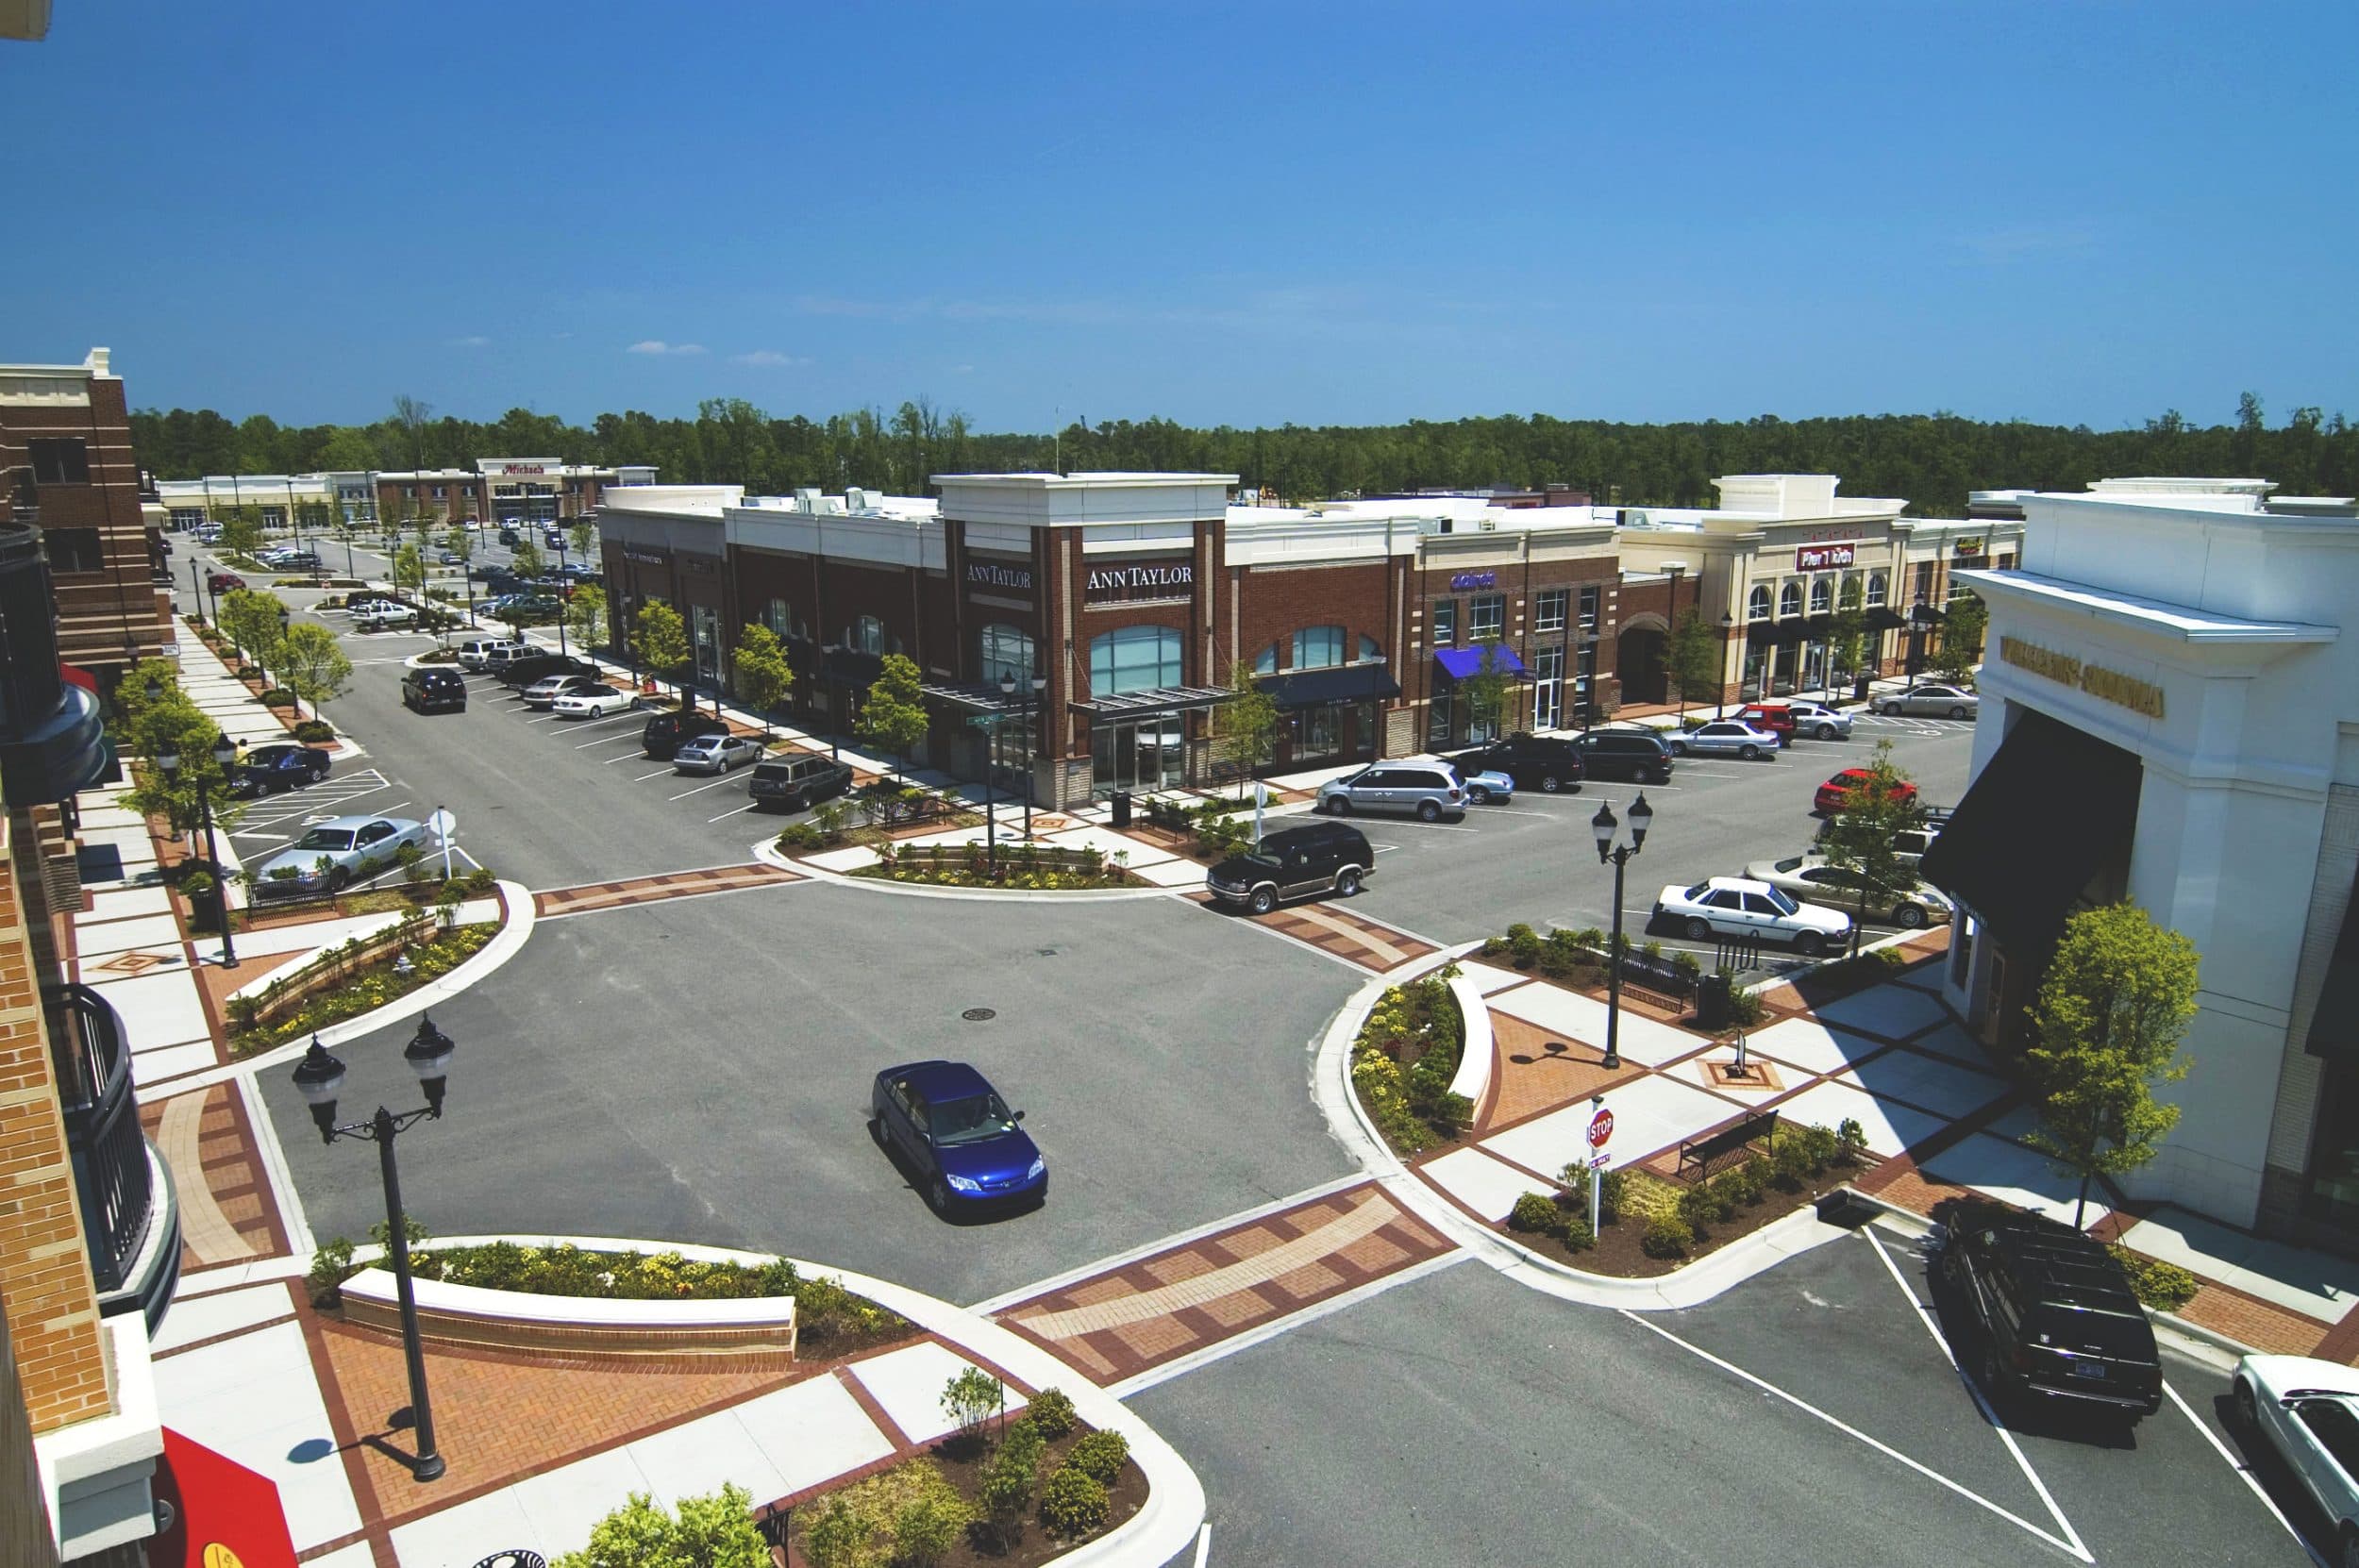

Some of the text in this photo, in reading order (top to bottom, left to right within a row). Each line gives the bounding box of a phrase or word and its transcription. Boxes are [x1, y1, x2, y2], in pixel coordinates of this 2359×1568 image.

[502, 465, 544, 475] Michaels
[1801, 552, 1822, 567] Pier
[1822, 551, 1829, 565] 1
[967, 564, 1031, 589] ANN TAYLOR
[1087, 567, 1193, 590] ANN TAYLOR
[1591, 1118, 1612, 1140] STOP
